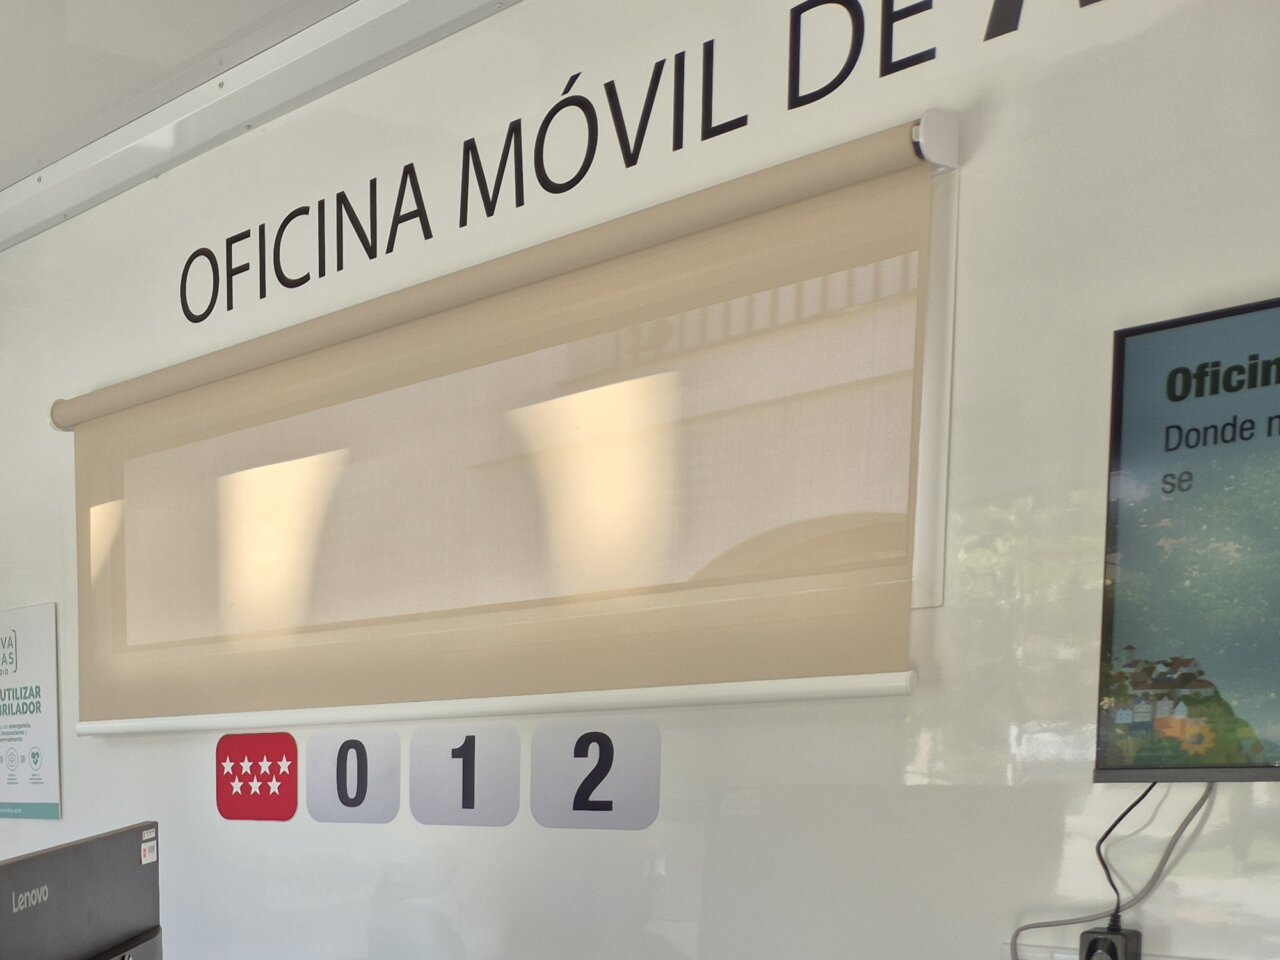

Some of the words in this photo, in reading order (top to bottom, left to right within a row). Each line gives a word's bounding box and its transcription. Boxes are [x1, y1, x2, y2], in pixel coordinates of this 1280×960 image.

[180, 162, 433, 324] OFICINA
[459, 39, 748, 229] MÓVIL
[787, 0, 937, 110] DE
[1164, 415, 1256, 452] Donde
[1161, 470, 1194, 495] se
[0, 685, 41, 702] UTILIZAR
[12, 884, 49, 914] Lenovo
